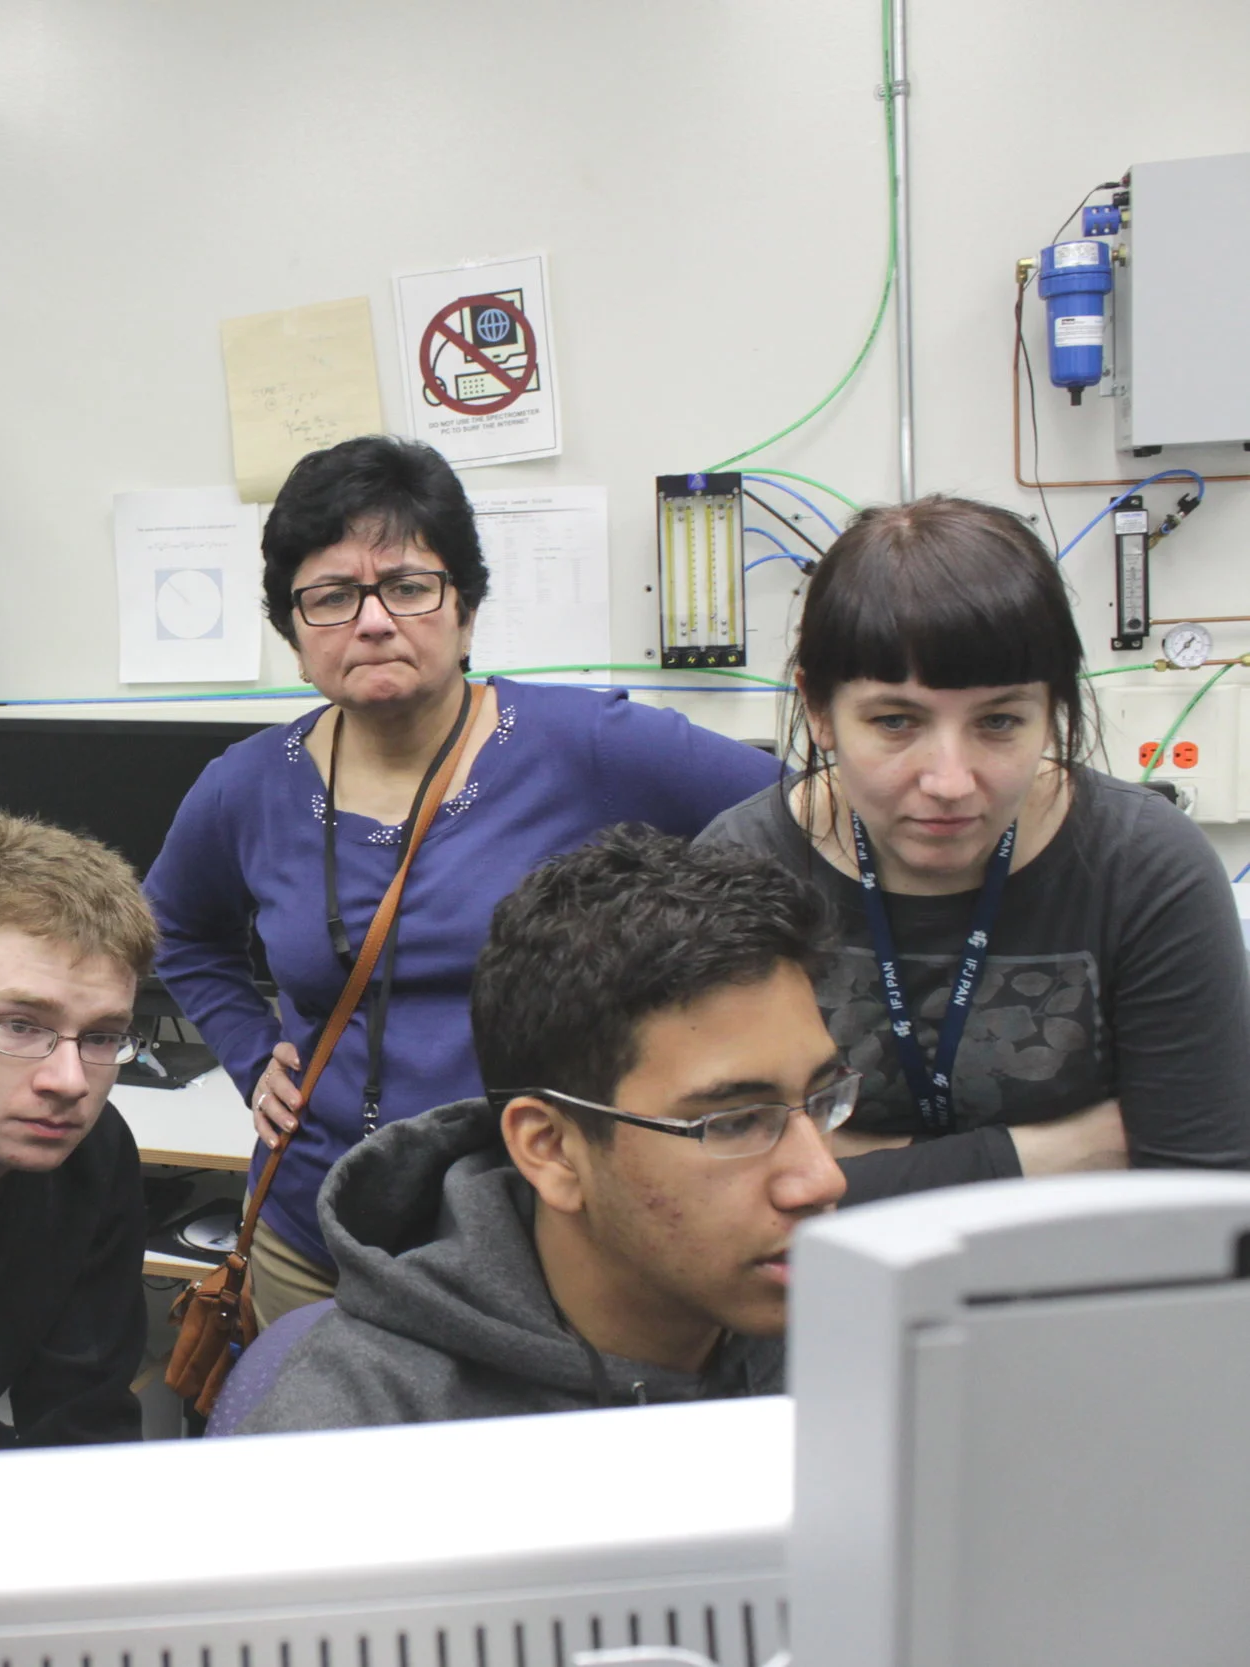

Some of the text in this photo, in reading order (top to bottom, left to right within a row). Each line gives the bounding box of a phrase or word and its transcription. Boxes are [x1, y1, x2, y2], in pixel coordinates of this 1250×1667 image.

[428, 408, 540, 430] DO NOT USE THE SPECTROMETER
[440, 417, 530, 435] PC TO SURF THE INTERNET
[881, 961, 904, 1010] IFJ PAN
[953, 957, 979, 1006] IFJ PAN
